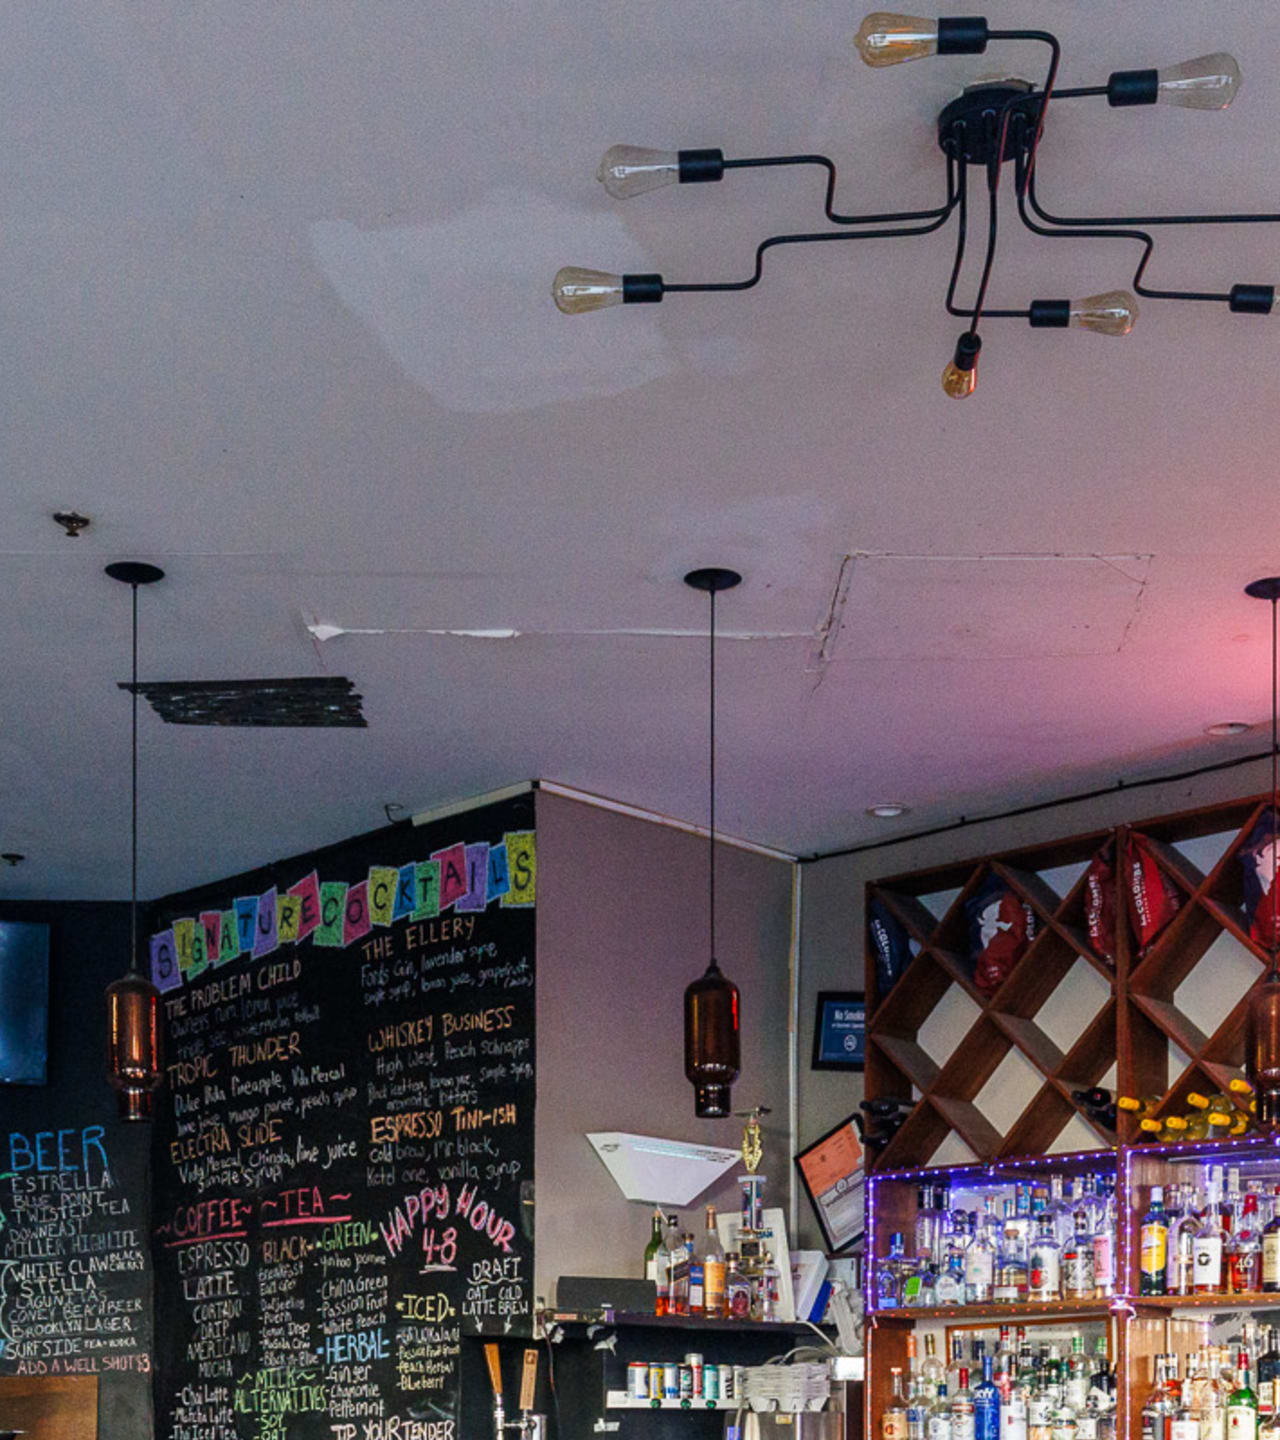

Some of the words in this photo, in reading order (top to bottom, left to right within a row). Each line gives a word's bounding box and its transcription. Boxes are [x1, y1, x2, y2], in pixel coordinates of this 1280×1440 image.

[158, 888, 316, 980] SIGNATURE
[320, 850, 532, 928] COCKTAILS
[361, 936, 395, 961] THE
[404, 916, 475, 951] ELLERY
[164, 995, 187, 1021] THE
[190, 972, 253, 1012] PROBLEM
[256, 959, 301, 991] CHILD
[367, 1014, 433, 1053] WHISKEY
[441, 1004, 516, 1038] BUSINESS
[167, 1053, 217, 1090] TROPIC
[227, 1031, 302, 1068] THUNDER
[170, 1122, 231, 1164] ELECTRA
[237, 1118, 283, 1149] SLIDE
[369, 1110, 444, 1144] ESPRESSO
[8, 1124, 111, 1173] BEER
[295, 1135, 320, 1163] lime
[322, 1134, 358, 1170] juice
[11, 1170, 115, 1195] ESTRELLA
[10, 1203, 93, 1225] TWISTED
[99, 1198, 131, 1216] TEA
[12, 1193, 52, 1209] BLUE
[60, 1190, 106, 1208] POINT
[173, 1197, 242, 1237] COFFEE
[279, 1185, 325, 1217] TEA
[9, 1218, 84, 1242] DOWNEAST
[379, 1182, 450, 1258] HAPPY
[455, 1183, 517, 1252] HOUR
[4, 1238, 67, 1259] MILLER
[322, 1219, 371, 1252] GREEN
[421, 1226, 459, 1266] 4-8
[177, 1241, 250, 1275] ESPRESSO
[262, 1236, 306, 1264] BLACK
[1235, 1252, 1255, 1270] 46
[9, 1259, 66, 1283] WHITE
[67, 1254, 108, 1276] CLAW
[471, 1256, 522, 1281] DRAFT
[19, 1273, 97, 1299] STELLA
[182, 1270, 240, 1300] LATTE
[355, 1274, 389, 1296] Green
[465, 1284, 489, 1302] OAT
[497, 1284, 523, 1302] COLD
[15, 1289, 108, 1310] LAGUNITAS
[105, 1298, 144, 1316] BEER
[192, 1299, 244, 1324] CORTADO
[401, 1292, 450, 1323] ICED
[461, 1300, 497, 1315] LATTE
[497, 1300, 529, 1315] BREW
[10, 1319, 83, 1340] BROOKLYN
[198, 1319, 231, 1342] DRIP
[186, 1330, 252, 1362] AMERICANO
[325, 1327, 390, 1364] HERBAL
[15, 1358, 49, 1377] ADD
[50, 1359, 63, 1375] A
[63, 1354, 101, 1374] WELL
[198, 1359, 234, 1379] MOCHA
[255, 1365, 298, 1391] MILK
[233, 1384, 327, 1414] ALTERNATIVES
